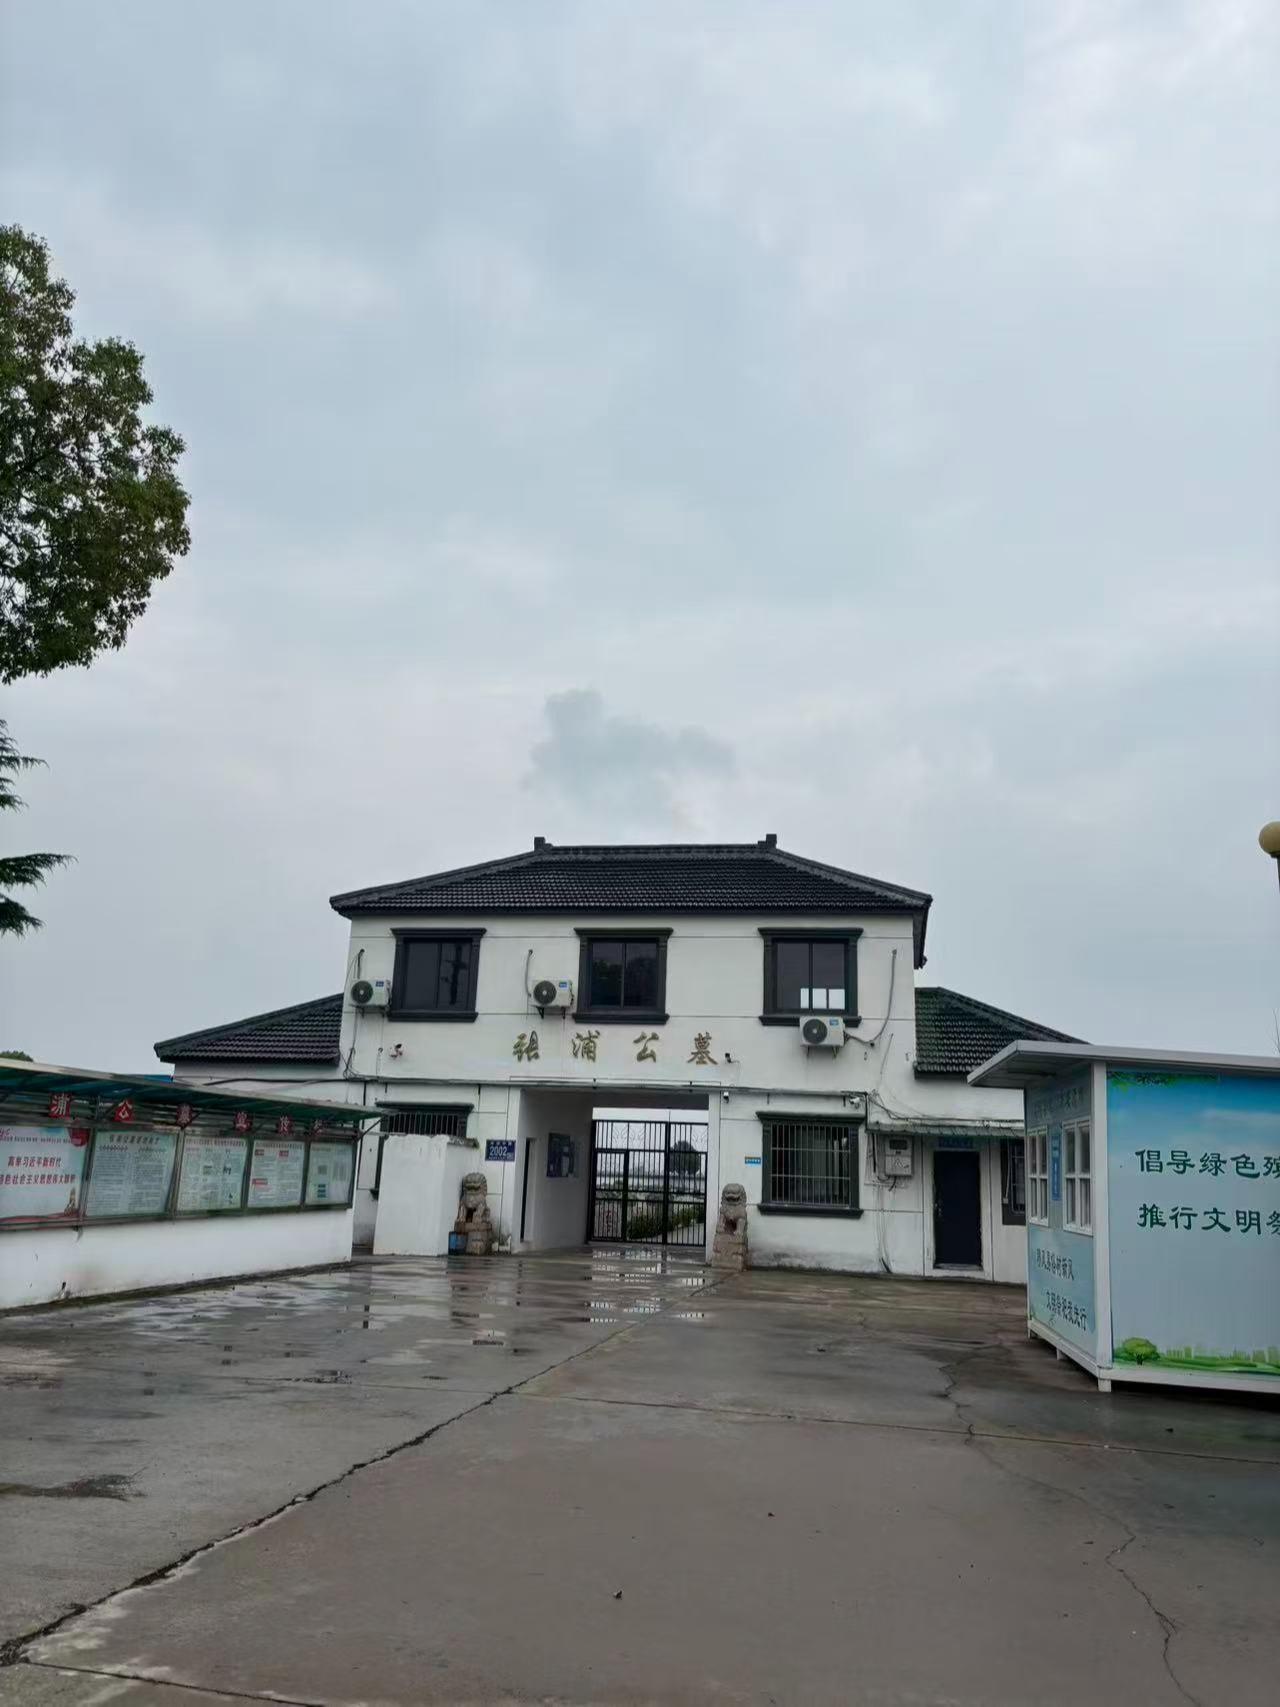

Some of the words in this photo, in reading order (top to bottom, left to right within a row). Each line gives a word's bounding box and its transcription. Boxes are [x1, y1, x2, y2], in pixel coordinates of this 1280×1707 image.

[512, 1030, 719, 1066] 张浦公墓
[489, 1146, 508, 1156] 2002
[1135, 1148, 1280, 1179] 倡导绿色殡
